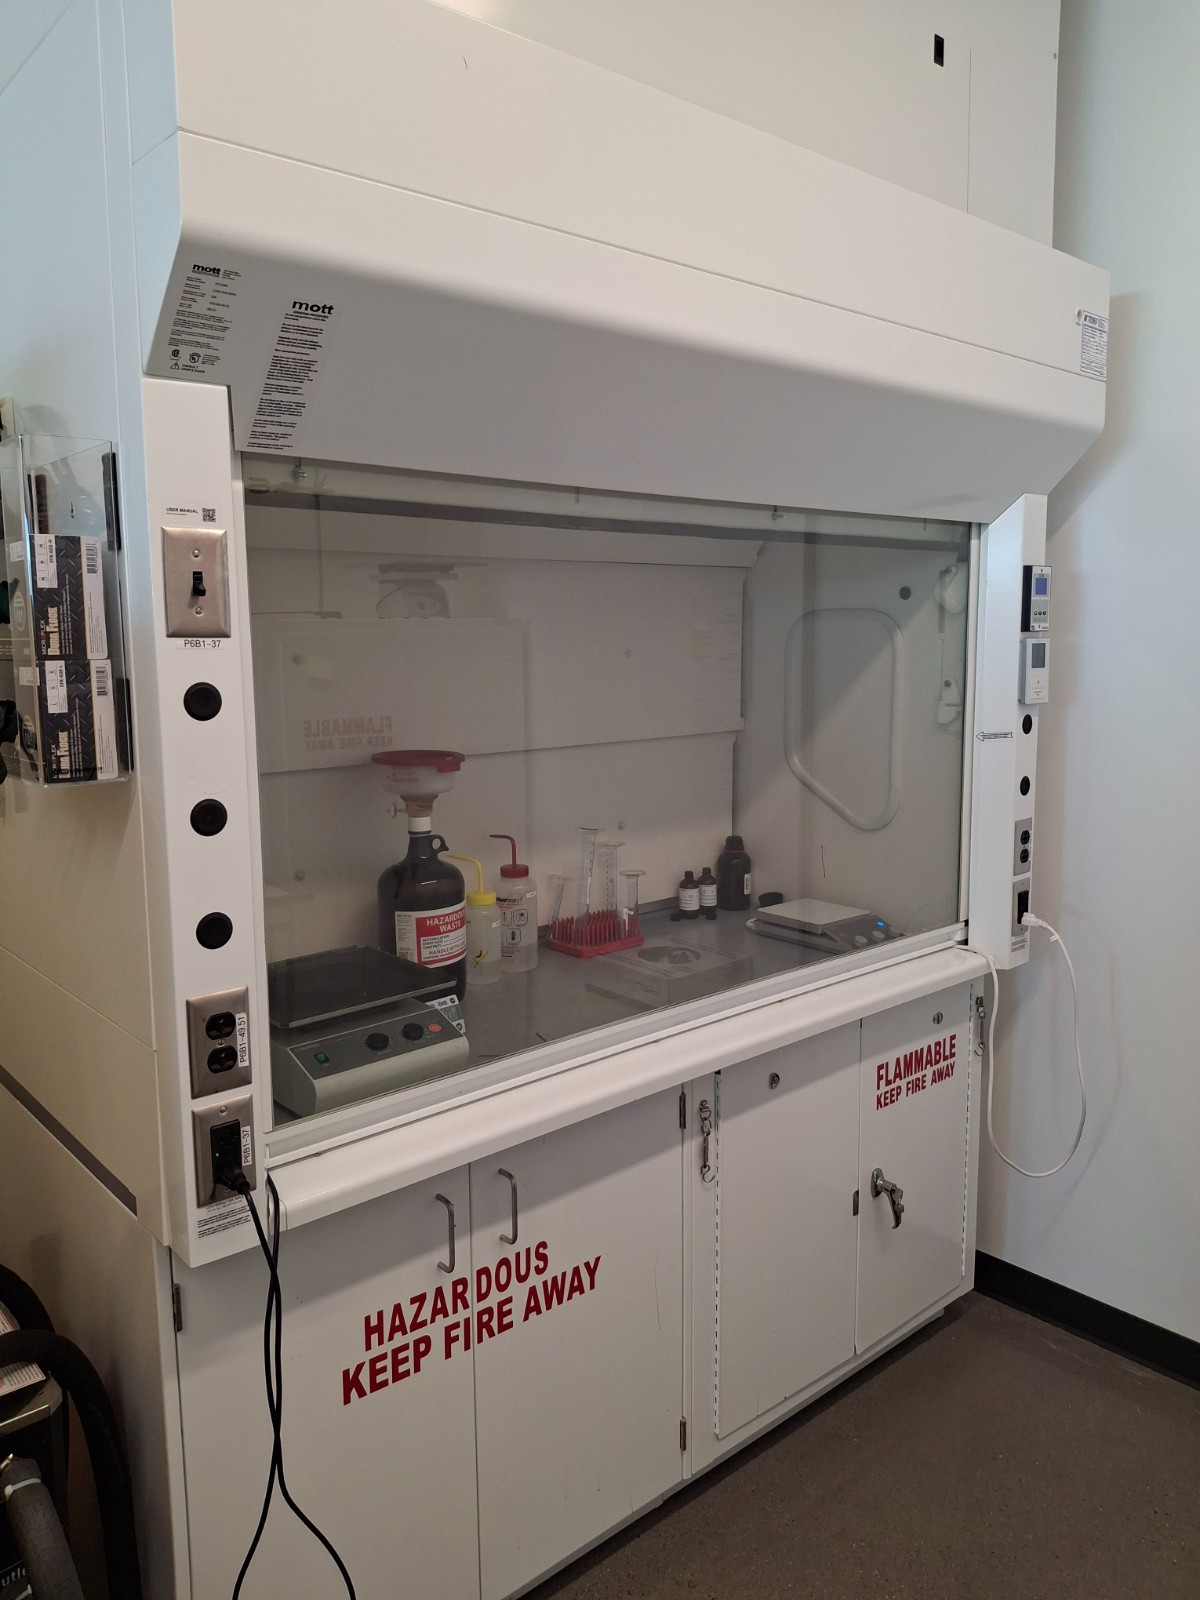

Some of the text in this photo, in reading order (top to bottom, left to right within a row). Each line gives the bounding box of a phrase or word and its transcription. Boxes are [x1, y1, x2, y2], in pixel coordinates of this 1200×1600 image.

[192, 264, 221, 275] mott
[292, 300, 334, 315] mott
[46, 606, 60, 656] DURA FLOCK
[184, 639, 221, 648] P6B1-37
[57, 731, 69, 756] FLOCK
[440, 920, 461, 933] WASTE
[876, 1034, 956, 1090] FLAMMABLE
[876, 1061, 956, 1110] KEEP FIRE AWAY
[243, 1130, 251, 1164] P6B1-37
[364, 1240, 548, 1351] HAZARDOUS
[342, 1255, 602, 1406] KEEP FIRE AWAY
